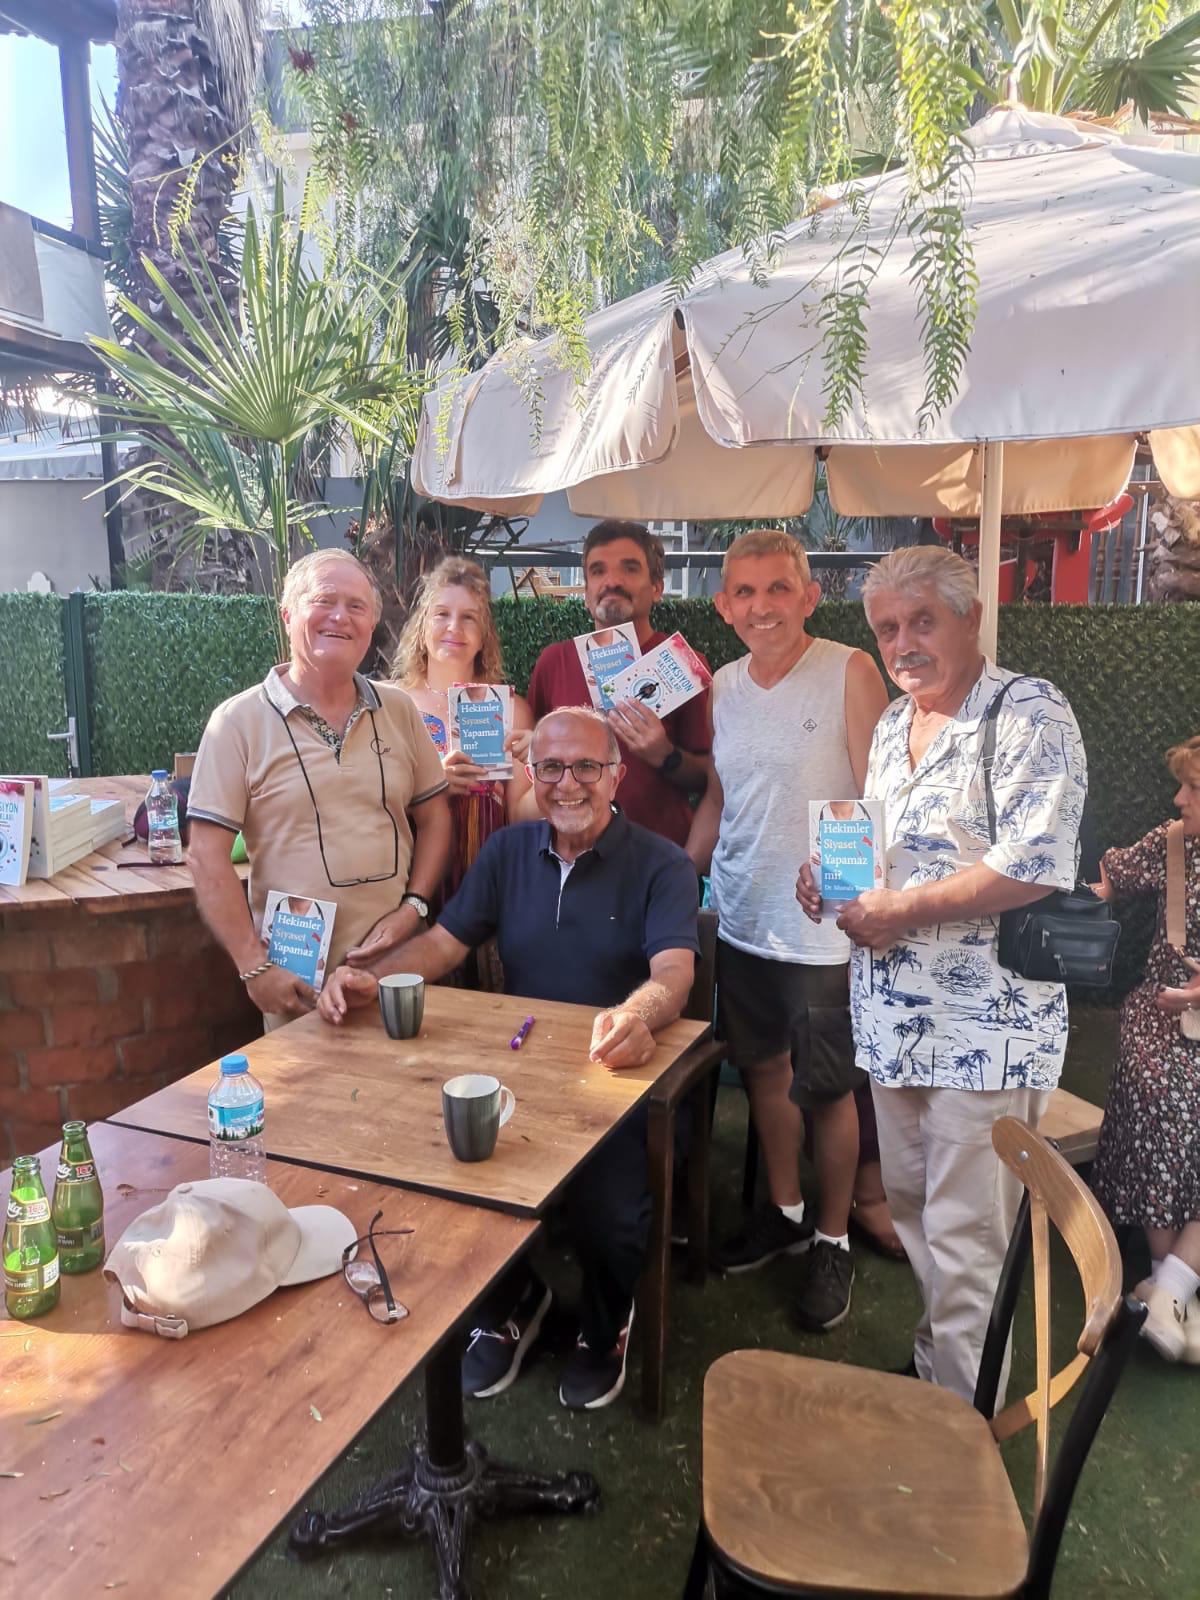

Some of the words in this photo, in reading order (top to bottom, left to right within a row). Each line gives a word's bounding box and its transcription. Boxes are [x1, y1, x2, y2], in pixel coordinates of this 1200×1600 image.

[591, 644, 629, 659] Hekimler
[461, 703, 499, 713] Hekimler
[463, 729, 499, 739] Yapamaz
[823, 823, 869, 833] Hekimler
[823, 839, 857, 852] Siyaset
[824, 855, 868, 868] Yapamaz
[277, 914, 321, 930] Hekimler
[275, 928, 306, 942] Siyaset
[273, 941, 314, 957] Yapamaz
